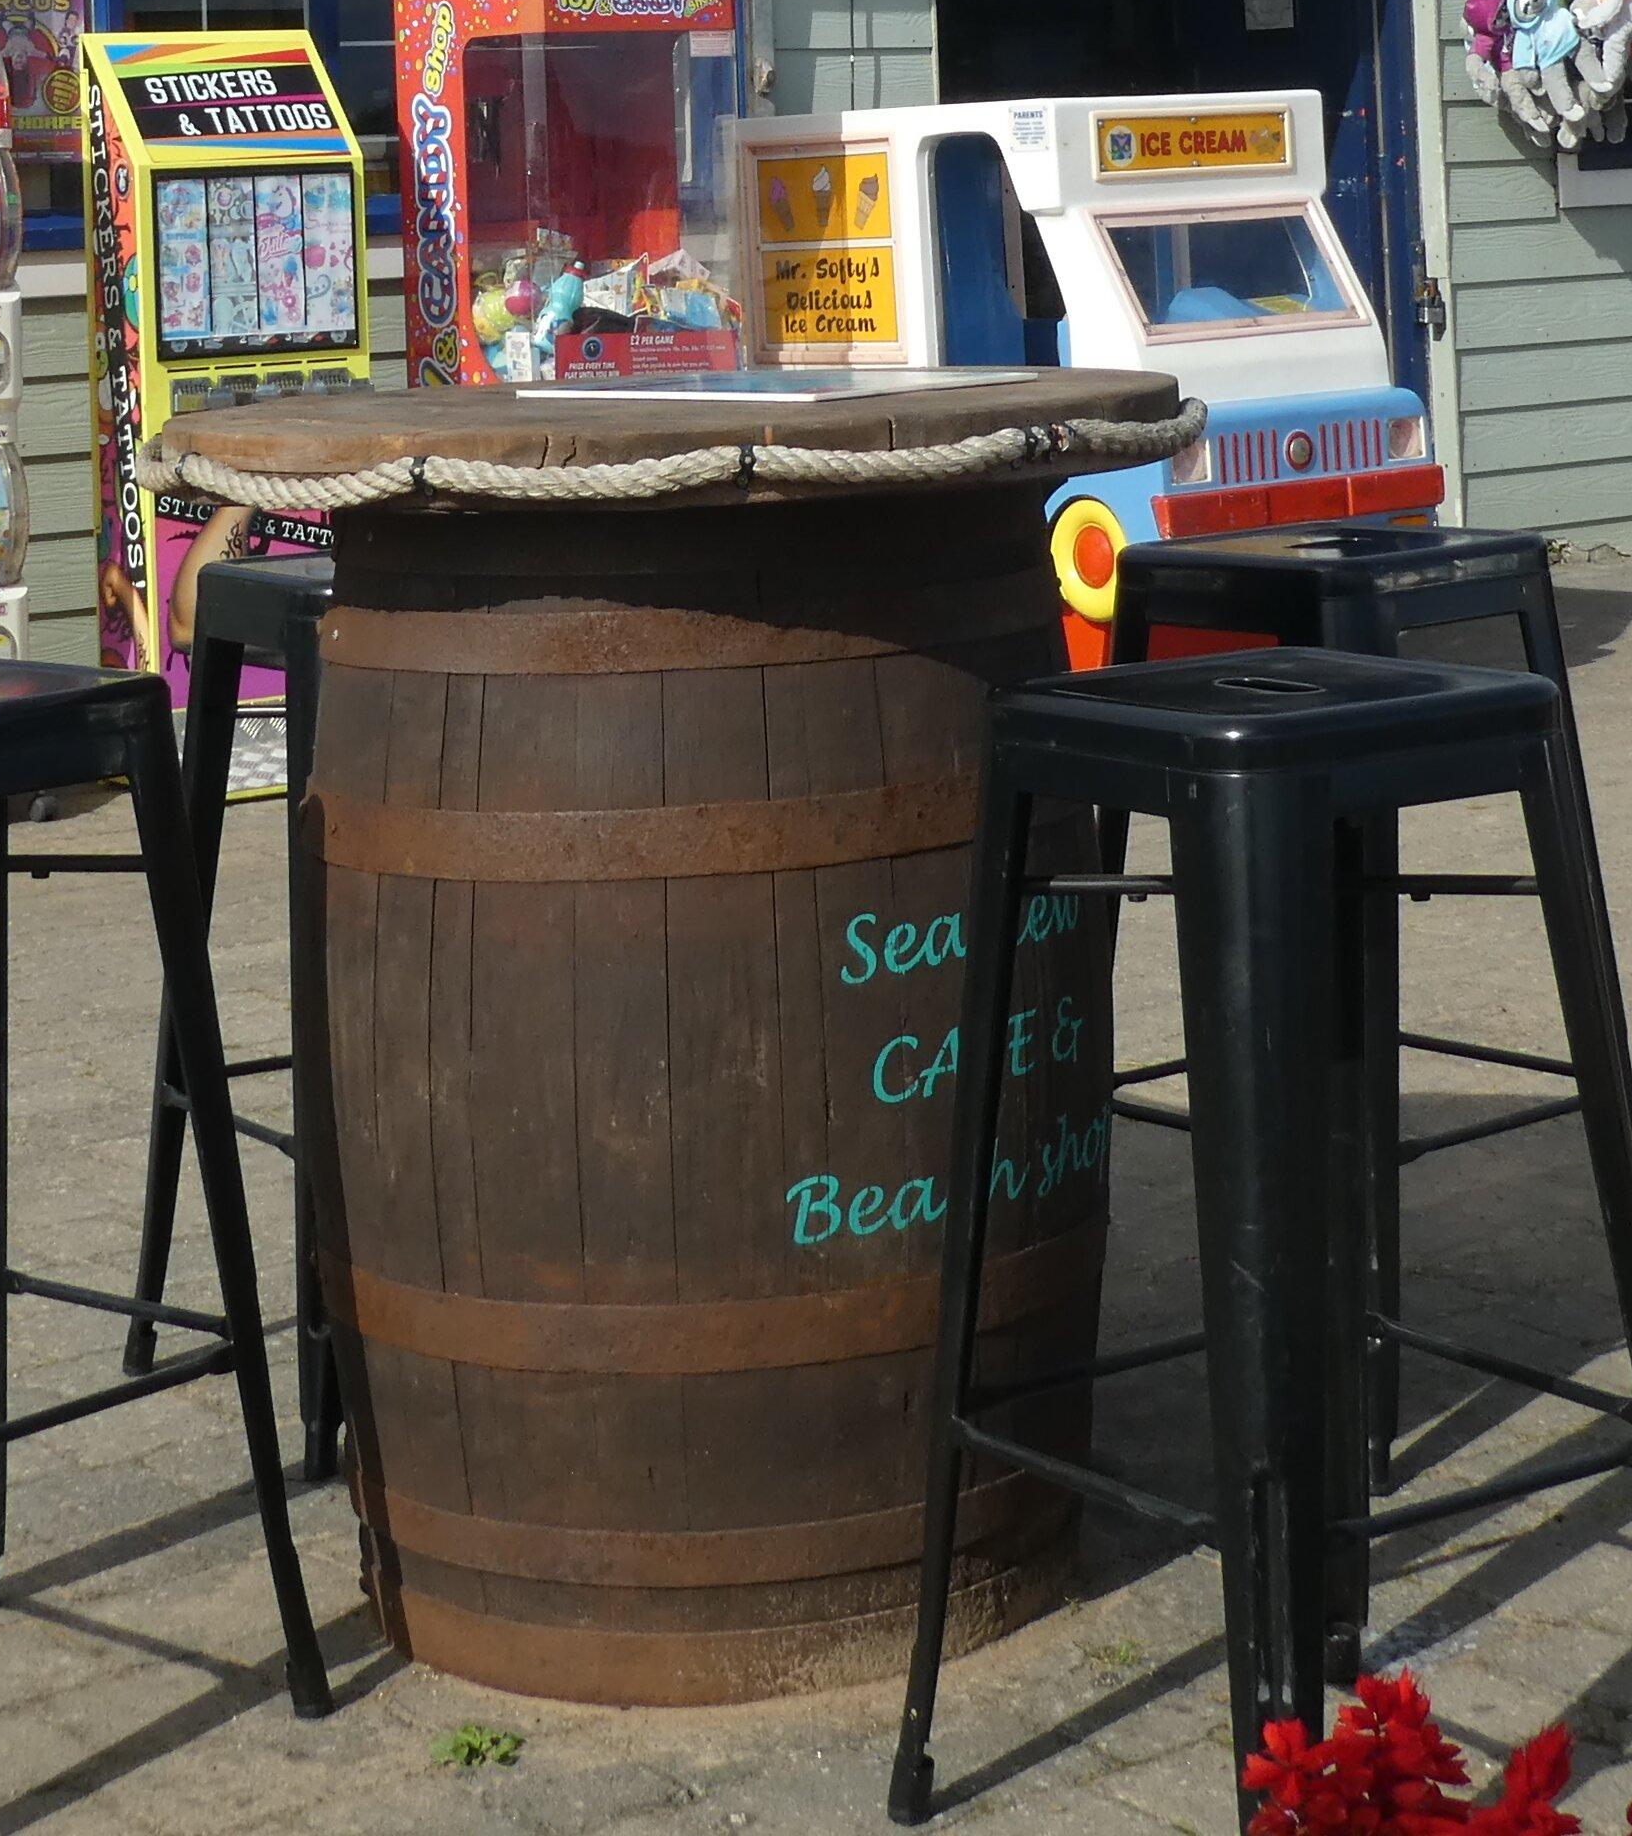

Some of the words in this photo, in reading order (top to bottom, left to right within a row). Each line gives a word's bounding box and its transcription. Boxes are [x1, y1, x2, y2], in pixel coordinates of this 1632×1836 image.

[145, 70, 277, 105] STICKERS
[179, 113, 201, 136] &
[204, 104, 332, 135] TATTOOS
[1013, 110, 1043, 119] PARENTS
[1140, 131, 1171, 157] ICE
[1178, 129, 1247, 155] CREAM
[87, 84, 119, 310] STICKERS
[107, 327, 123, 352] &
[412, 93, 457, 328] CANDY
[776, 259, 806, 281] Mr.
[816, 257, 879, 284] Softy's
[787, 289, 873, 310] Delicious
[785, 315, 807, 333] Ice
[816, 315, 876, 333] Cream
[630, 335, 639, 346] £2
[641, 335, 654, 346] PER
[655, 335, 674, 345] GAME
[265, 519, 276, 535] &
[281, 521, 335, 546] TATT
[840, 894, 1078, 986] Seaew
[873, 1008, 1037, 1104] CAE
[1052, 996, 1083, 1063] &
[786, 1137, 1030, 1245] Beah
